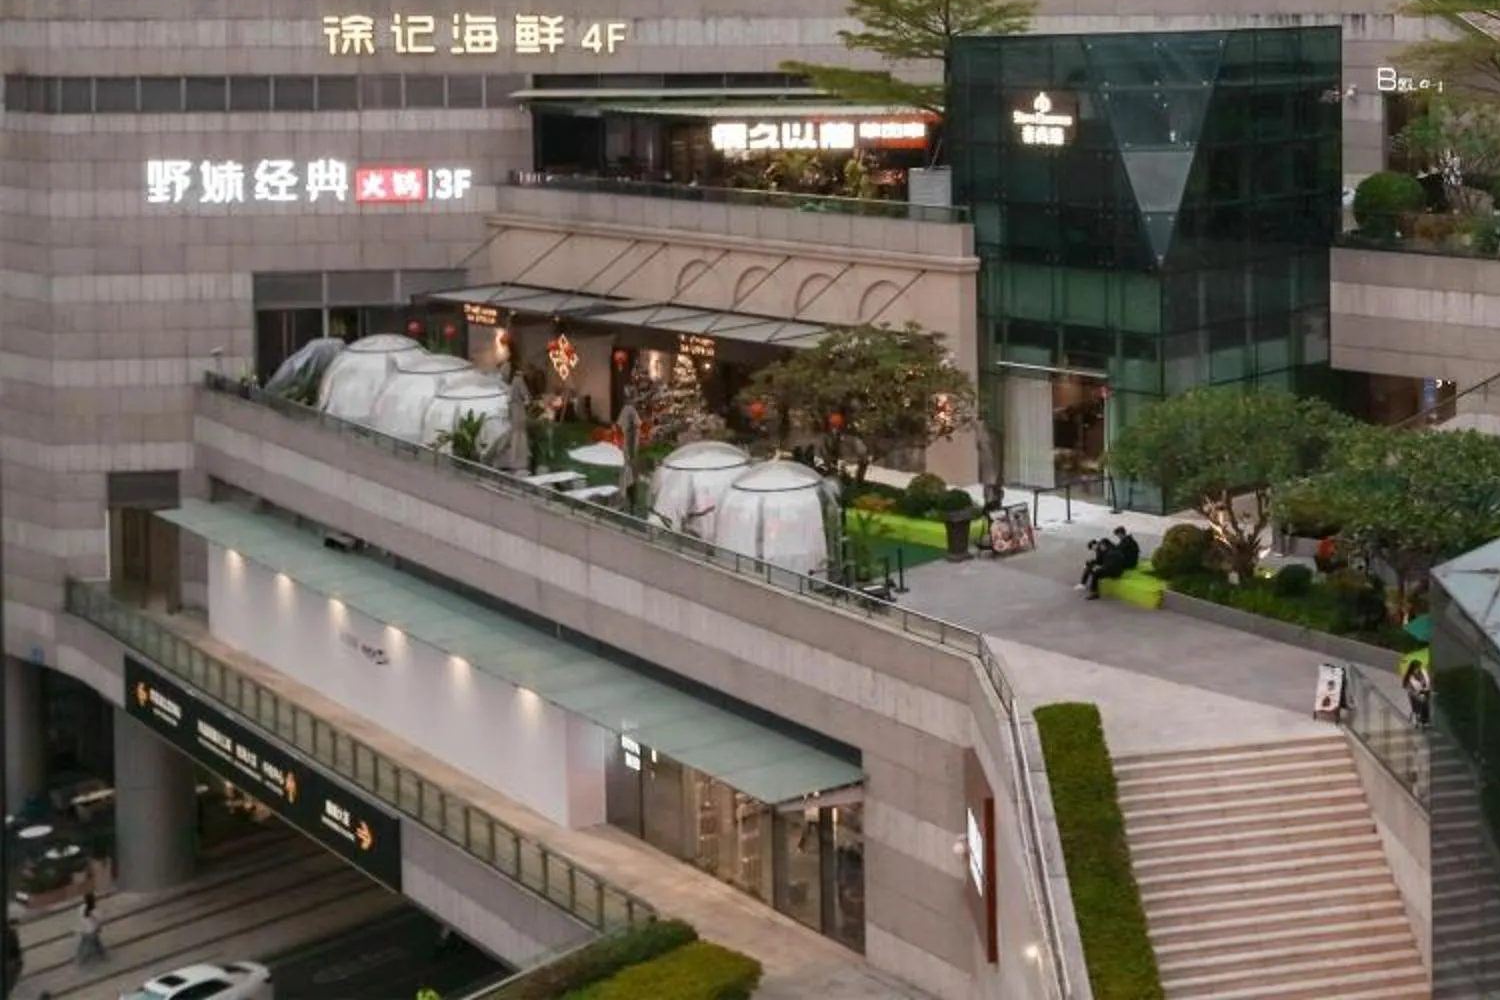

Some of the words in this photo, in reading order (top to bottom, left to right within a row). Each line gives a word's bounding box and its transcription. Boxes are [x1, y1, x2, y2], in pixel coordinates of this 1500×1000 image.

[323, 13, 565, 55] 徐记海鲜
[581, 23, 627, 54] 4F
